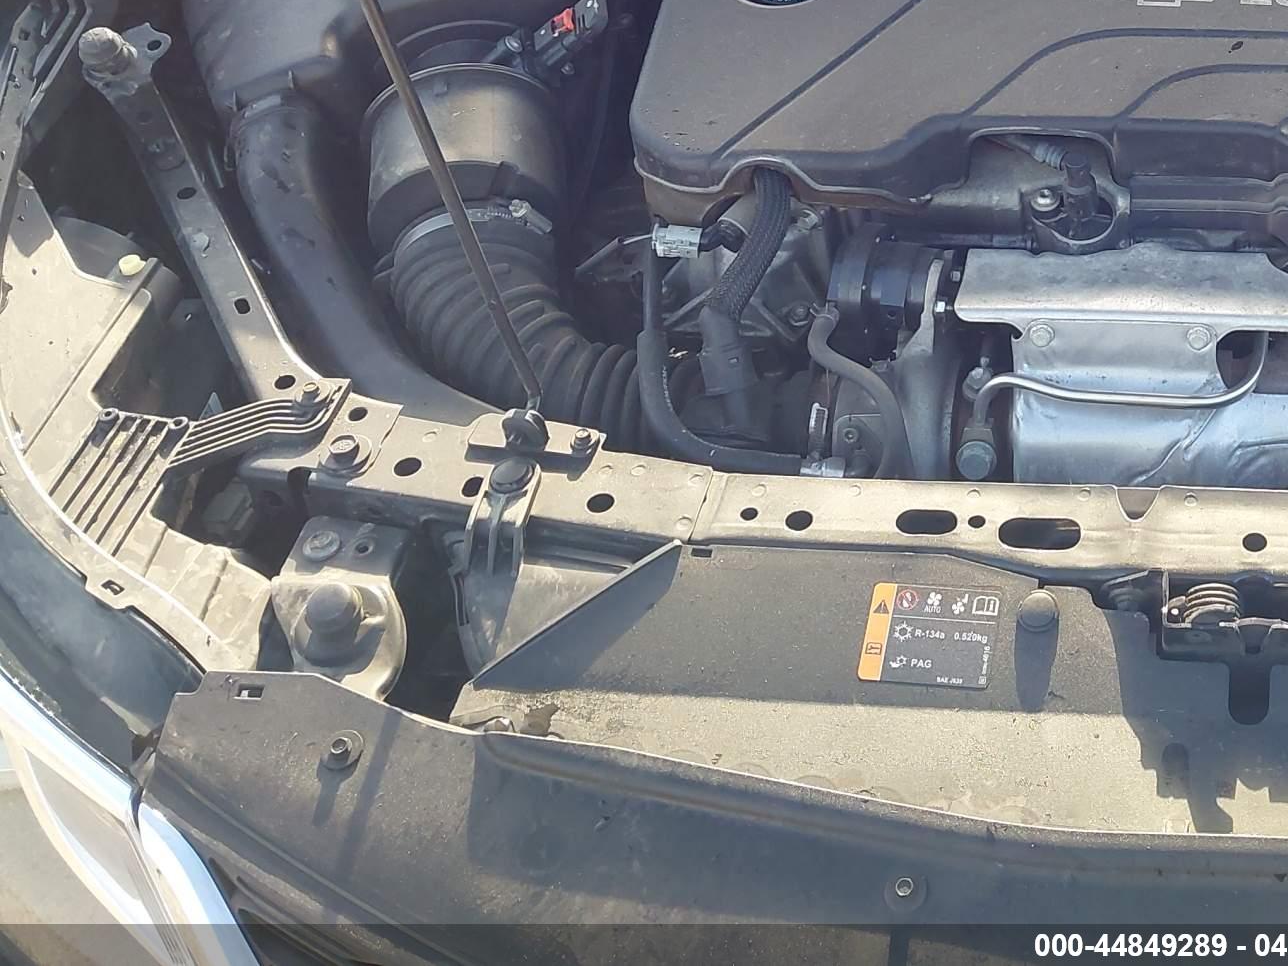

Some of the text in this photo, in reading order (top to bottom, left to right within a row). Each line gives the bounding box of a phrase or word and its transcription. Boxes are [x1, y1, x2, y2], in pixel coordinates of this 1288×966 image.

[923, 605, 942, 614] AUTO
[914, 629, 988, 644] R-134a 0.520kg
[910, 658, 932, 669] PAG
